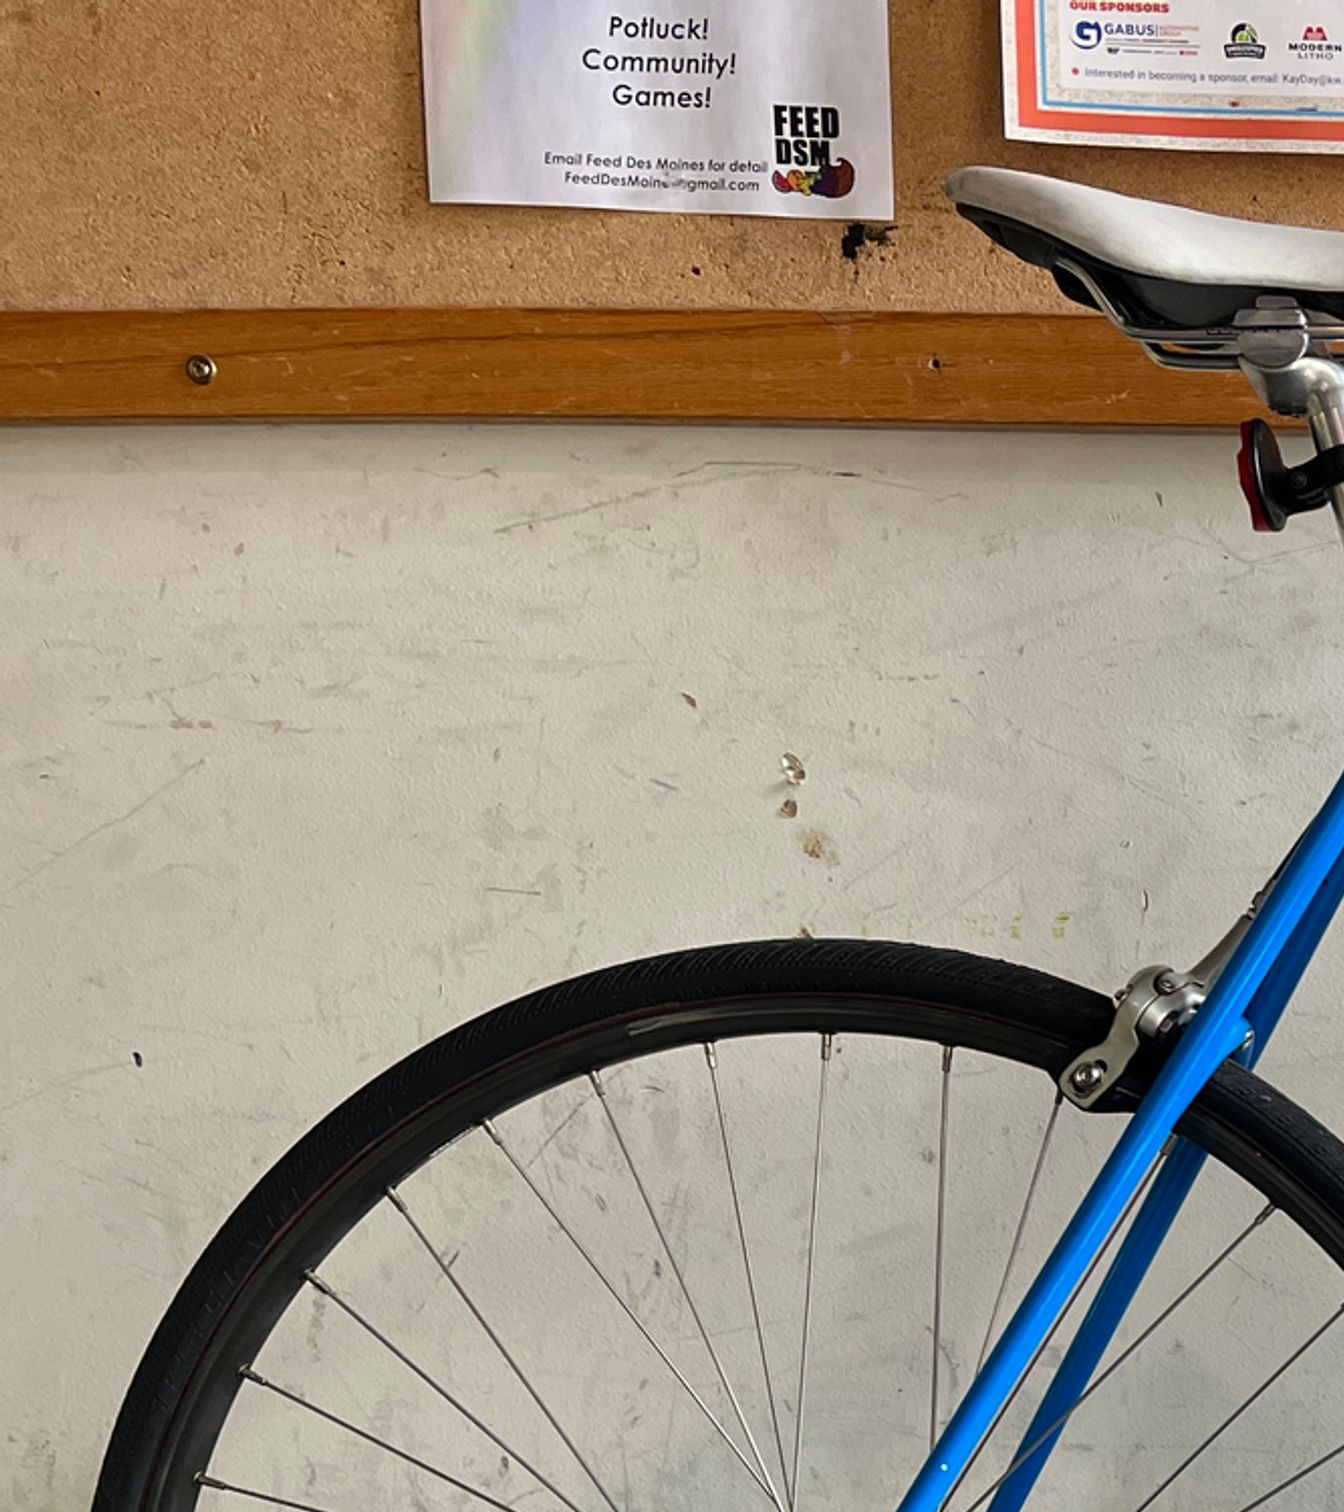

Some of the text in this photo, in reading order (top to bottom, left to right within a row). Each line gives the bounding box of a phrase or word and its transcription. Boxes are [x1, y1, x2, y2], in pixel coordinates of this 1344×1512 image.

[1070, 0, 1170, 13] OUR SPONSORS
[609, 16, 709, 40] Potluck!
[1104, 23, 1155, 36] GABUS
[1288, 43, 1343, 52] MODERN
[1298, 52, 1334, 61] LITHO
[582, 48, 736, 79] Community!
[1084, 68, 1135, 80] Interested
[1137, 69, 1146, 79] in
[1150, 70, 1197, 83] becoming
[612, 84, 711, 108] Games!
[773, 104, 840, 138] FEED
[544, 152, 582, 166] Email
[587, 154, 622, 168] Feed
[627, 156, 651, 169] Des
[656, 158, 704, 172] Moines
[708, 159, 726, 172] for
[775, 139, 831, 166] DSM
